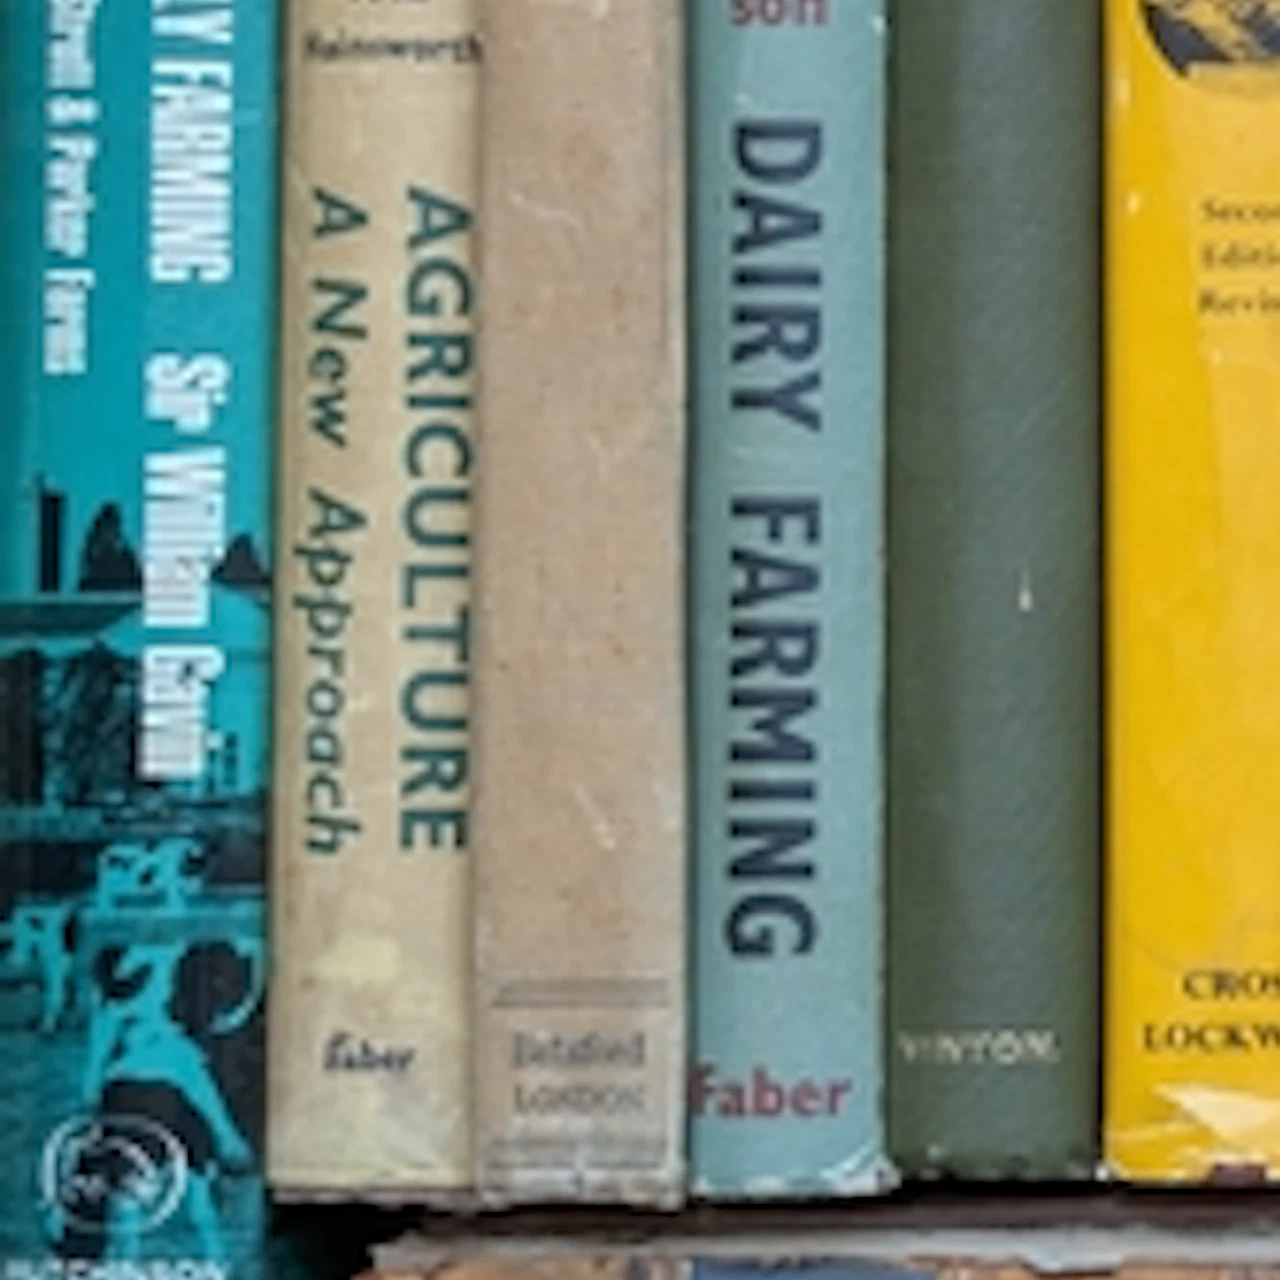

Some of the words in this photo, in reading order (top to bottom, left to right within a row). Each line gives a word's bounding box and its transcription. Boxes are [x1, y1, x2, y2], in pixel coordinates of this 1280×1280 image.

[150, 60, 236, 284] FARMING
[309, 185, 372, 239] A
[730, 119, 823, 433] DAIRY
[144, 354, 230, 435] Sir
[306, 275, 372, 451] New
[400, 184, 476, 854] AGRICULTURE
[294, 484, 370, 857] Approach
[723, 493, 821, 959] FARMING
